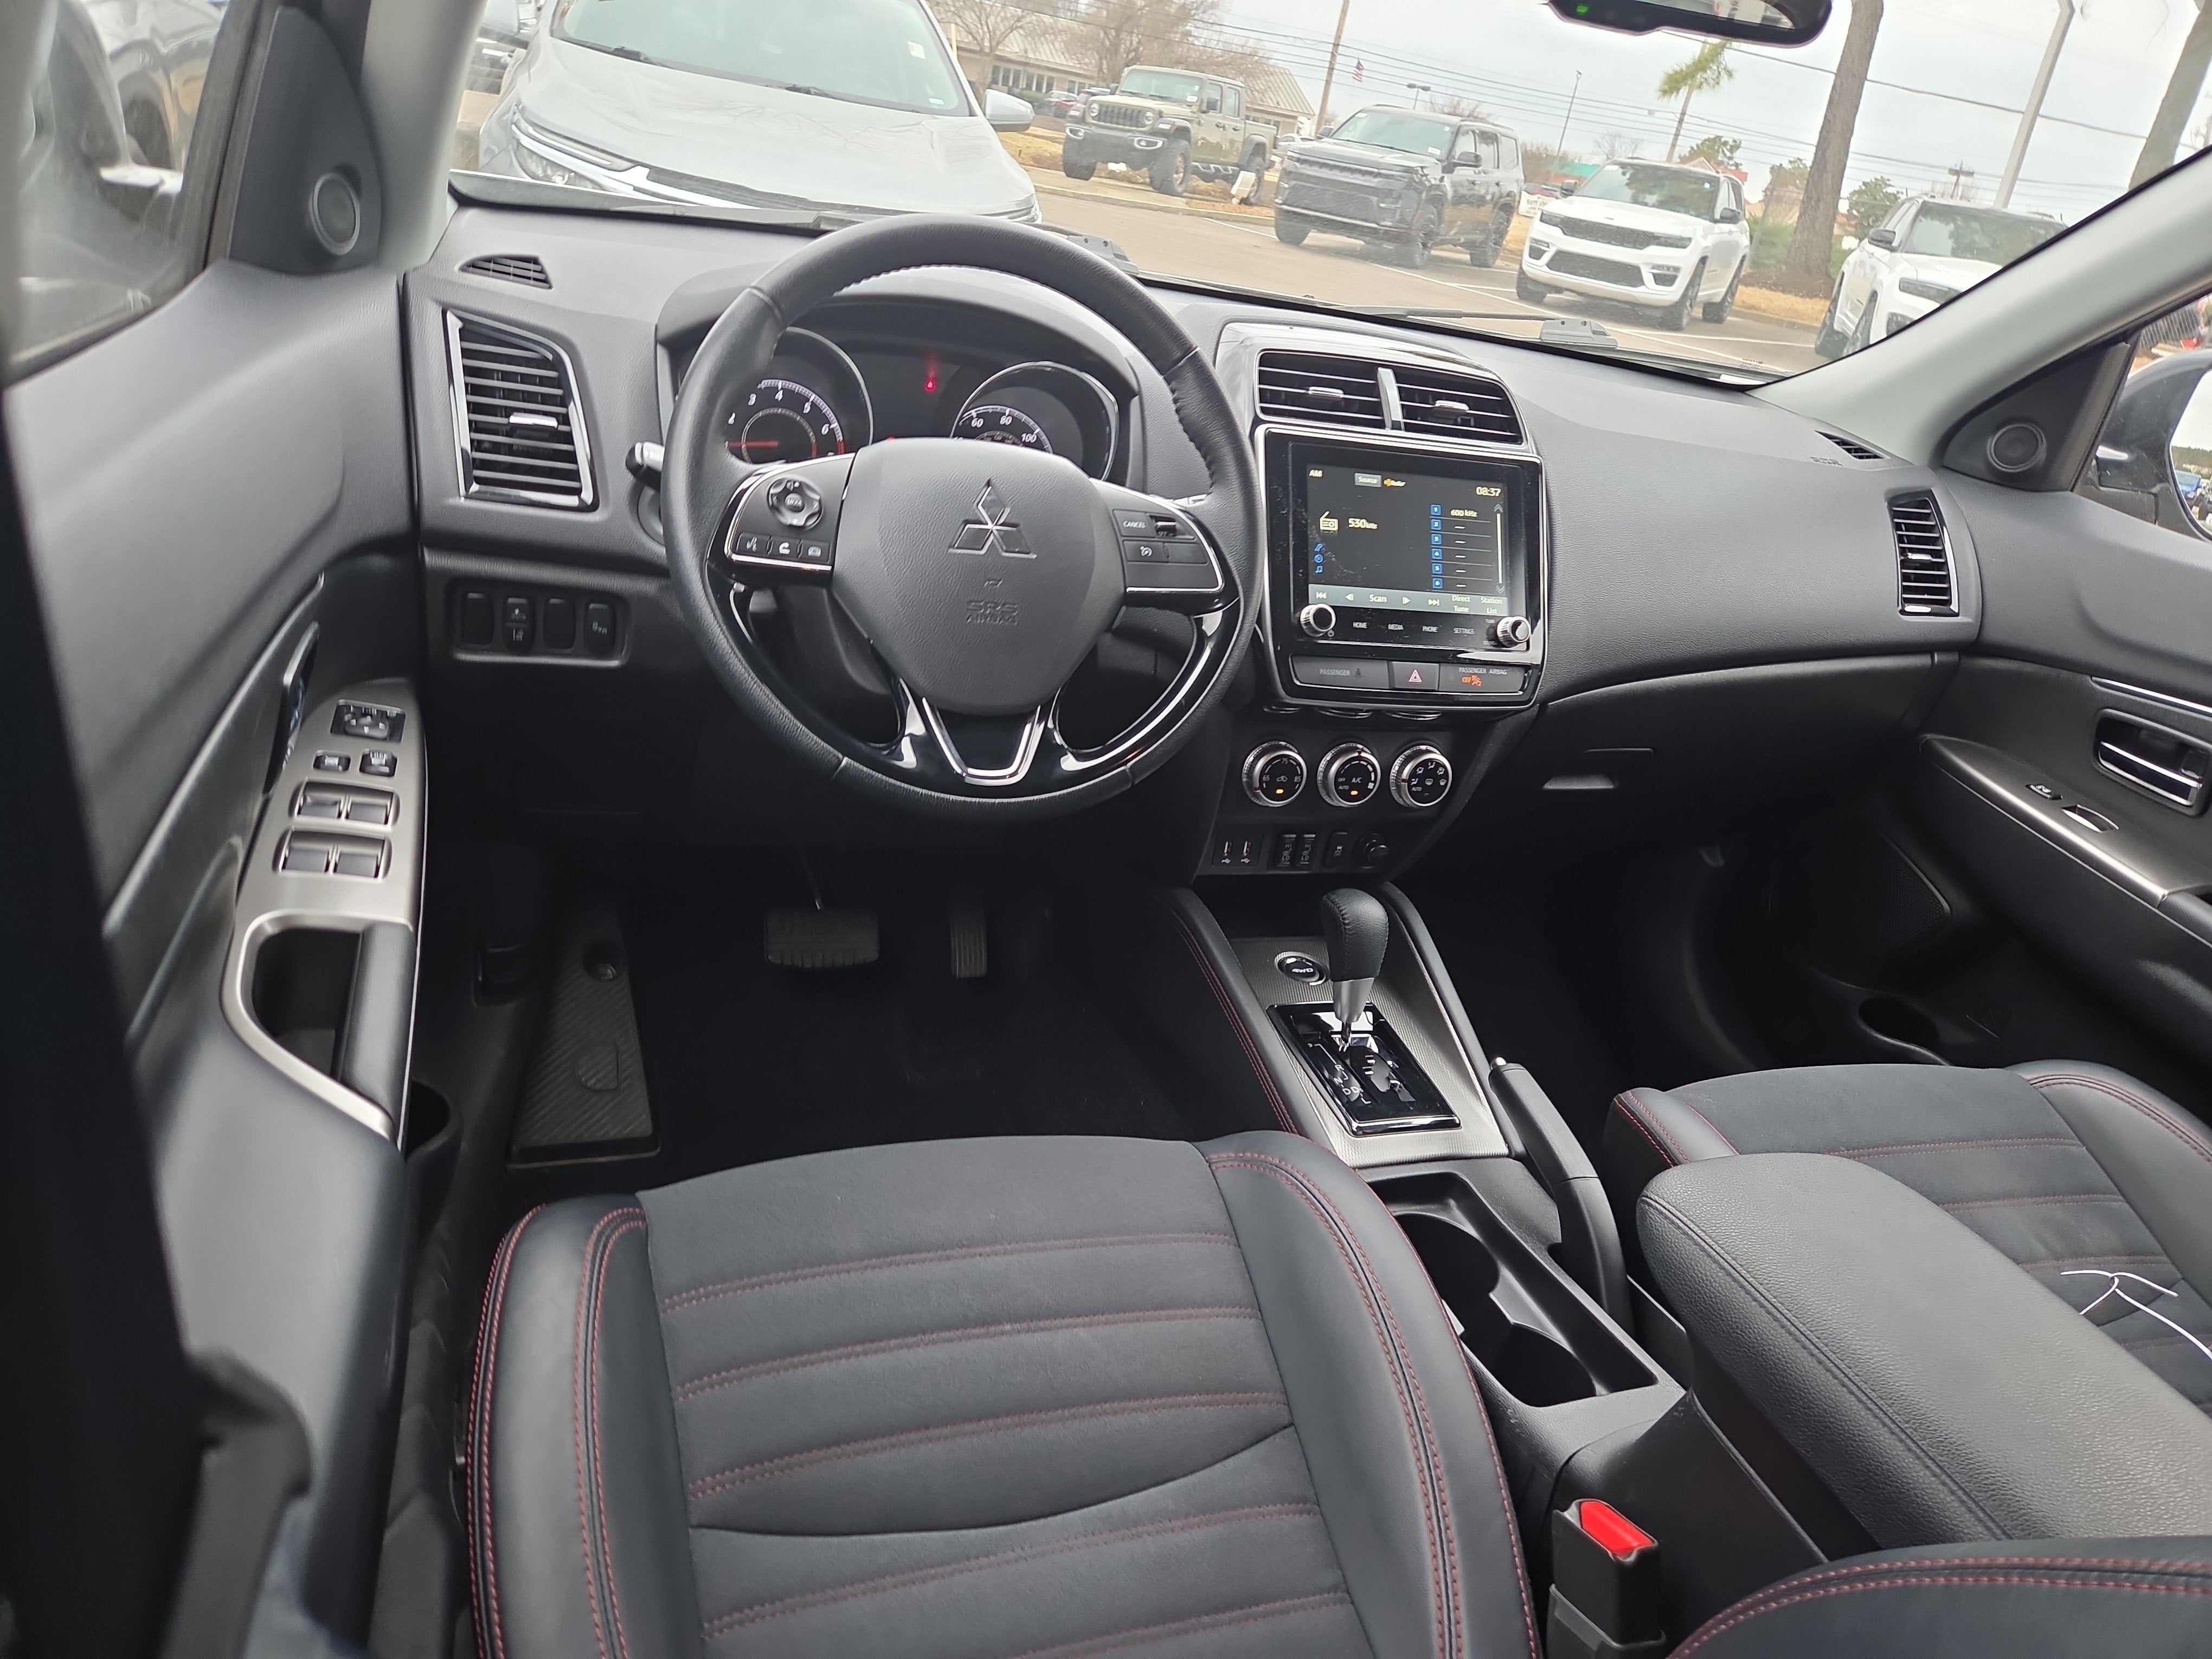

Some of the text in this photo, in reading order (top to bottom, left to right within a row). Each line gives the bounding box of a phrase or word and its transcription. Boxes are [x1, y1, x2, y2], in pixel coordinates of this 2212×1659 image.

[748, 393, 756, 406] 3
[775, 390, 783, 402] 4
[803, 402, 812, 414] 5
[971, 417, 984, 428] 60
[999, 415, 1012, 426] 80
[821, 423, 829, 435] 6
[1021, 433, 1037, 443] 100
[1309, 470, 1323, 478] AM
[1358, 476, 1378, 484] Source
[1476, 486, 1501, 497] 08:37
[1123, 520, 1146, 529] CANCEL
[1369, 594, 1387, 603] Scan
[1334, 1077, 1343, 1085] N
[1342, 1088, 1351, 1096] D
